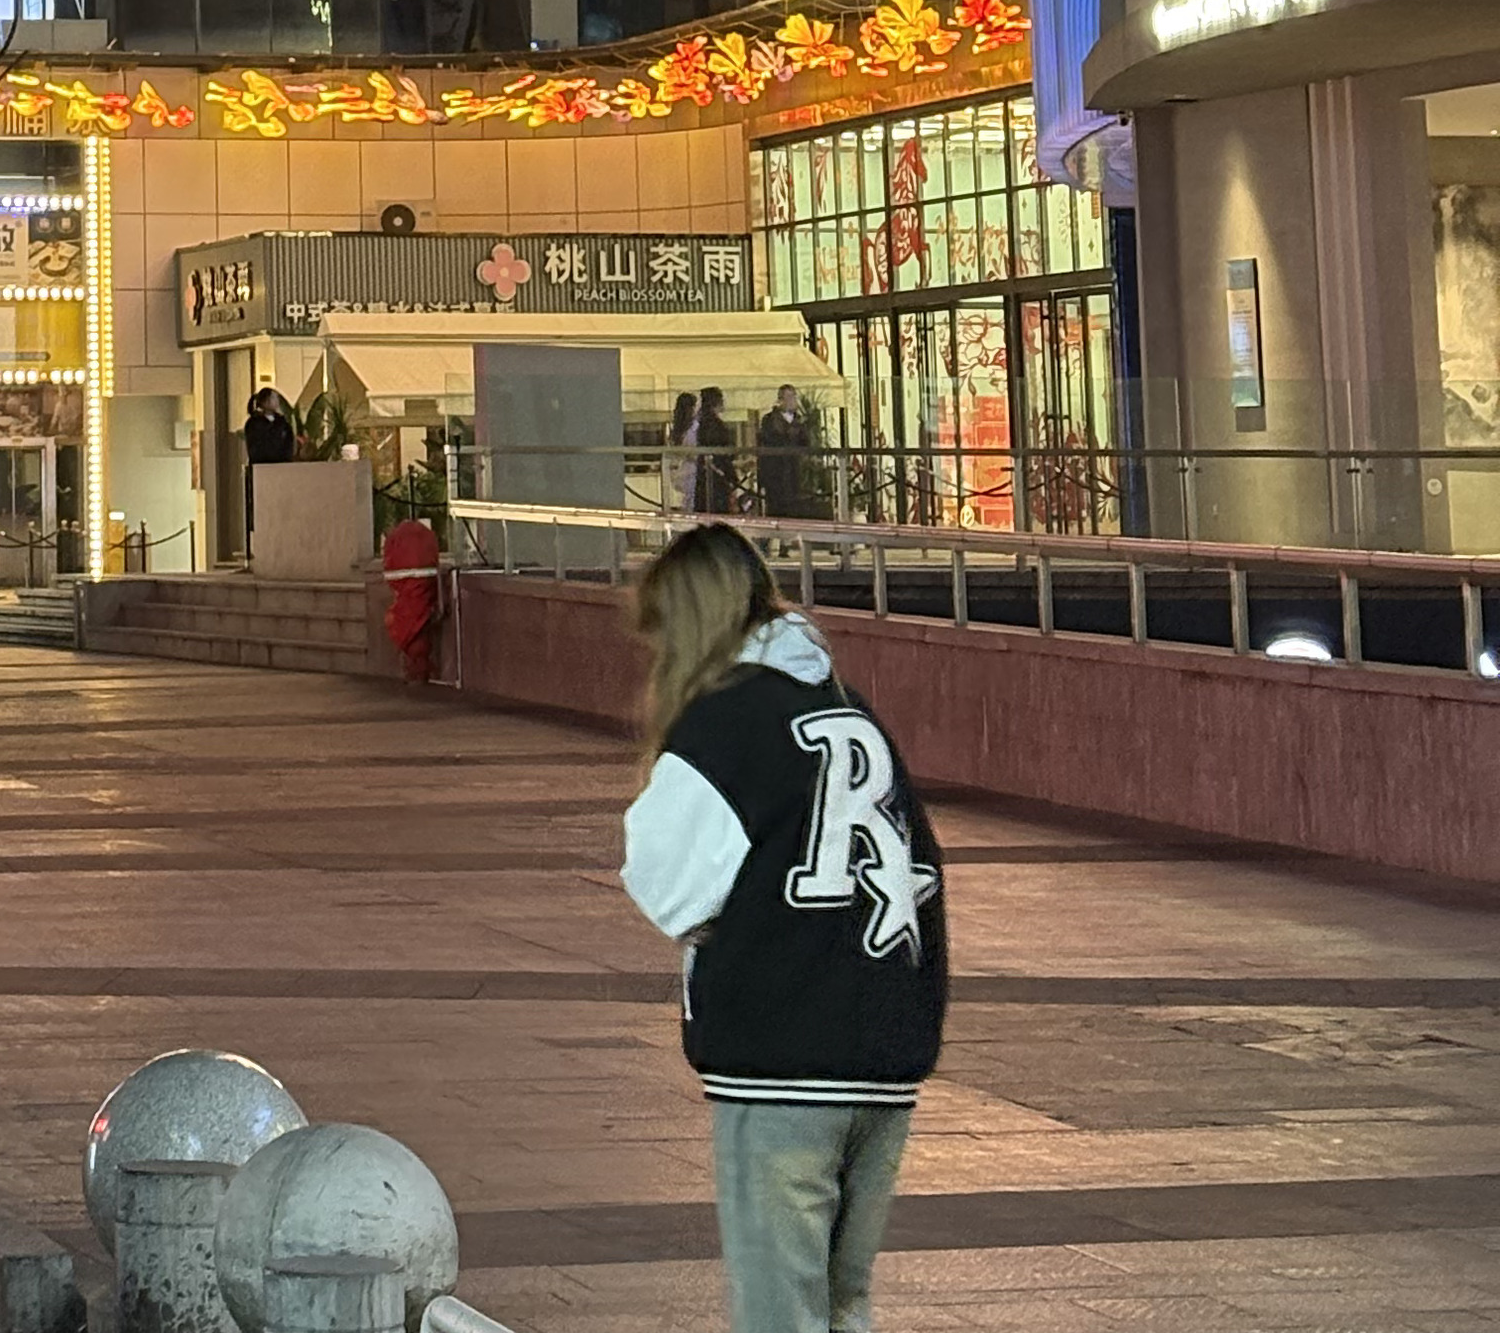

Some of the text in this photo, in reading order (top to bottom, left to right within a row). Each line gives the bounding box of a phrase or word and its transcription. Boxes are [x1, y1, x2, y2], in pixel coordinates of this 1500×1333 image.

[544, 242, 742, 285] 桃山茶雨
[574, 288, 617, 302] PEACH
[679, 289, 705, 302] TEA
